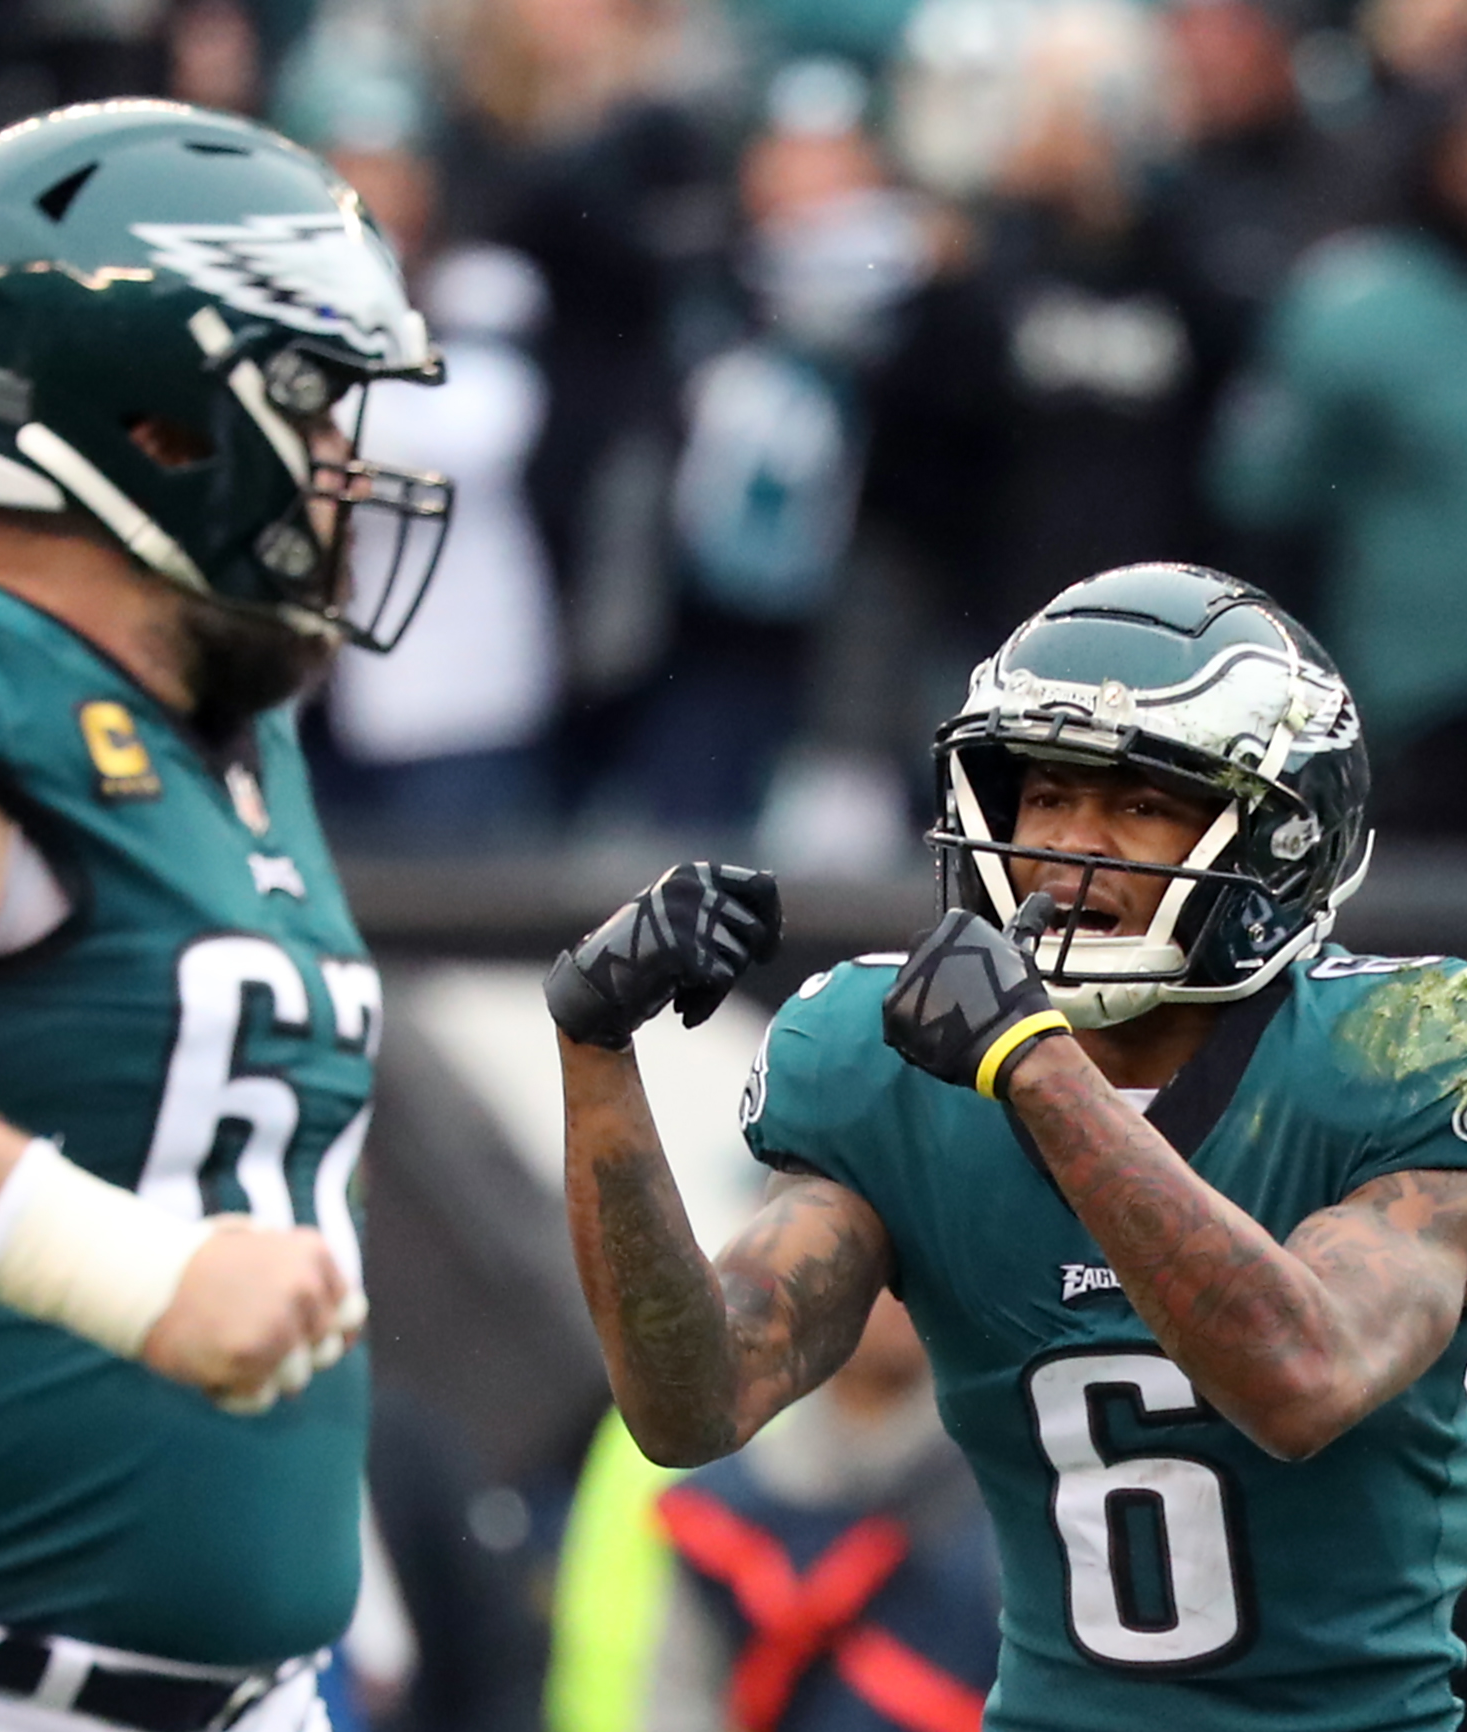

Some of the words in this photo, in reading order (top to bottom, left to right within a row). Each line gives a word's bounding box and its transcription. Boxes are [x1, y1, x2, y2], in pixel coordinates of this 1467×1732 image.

[80, 702, 151, 778] C
[1059, 1264, 1122, 1301] EAGL
[1031, 1354, 1239, 1661] 6
